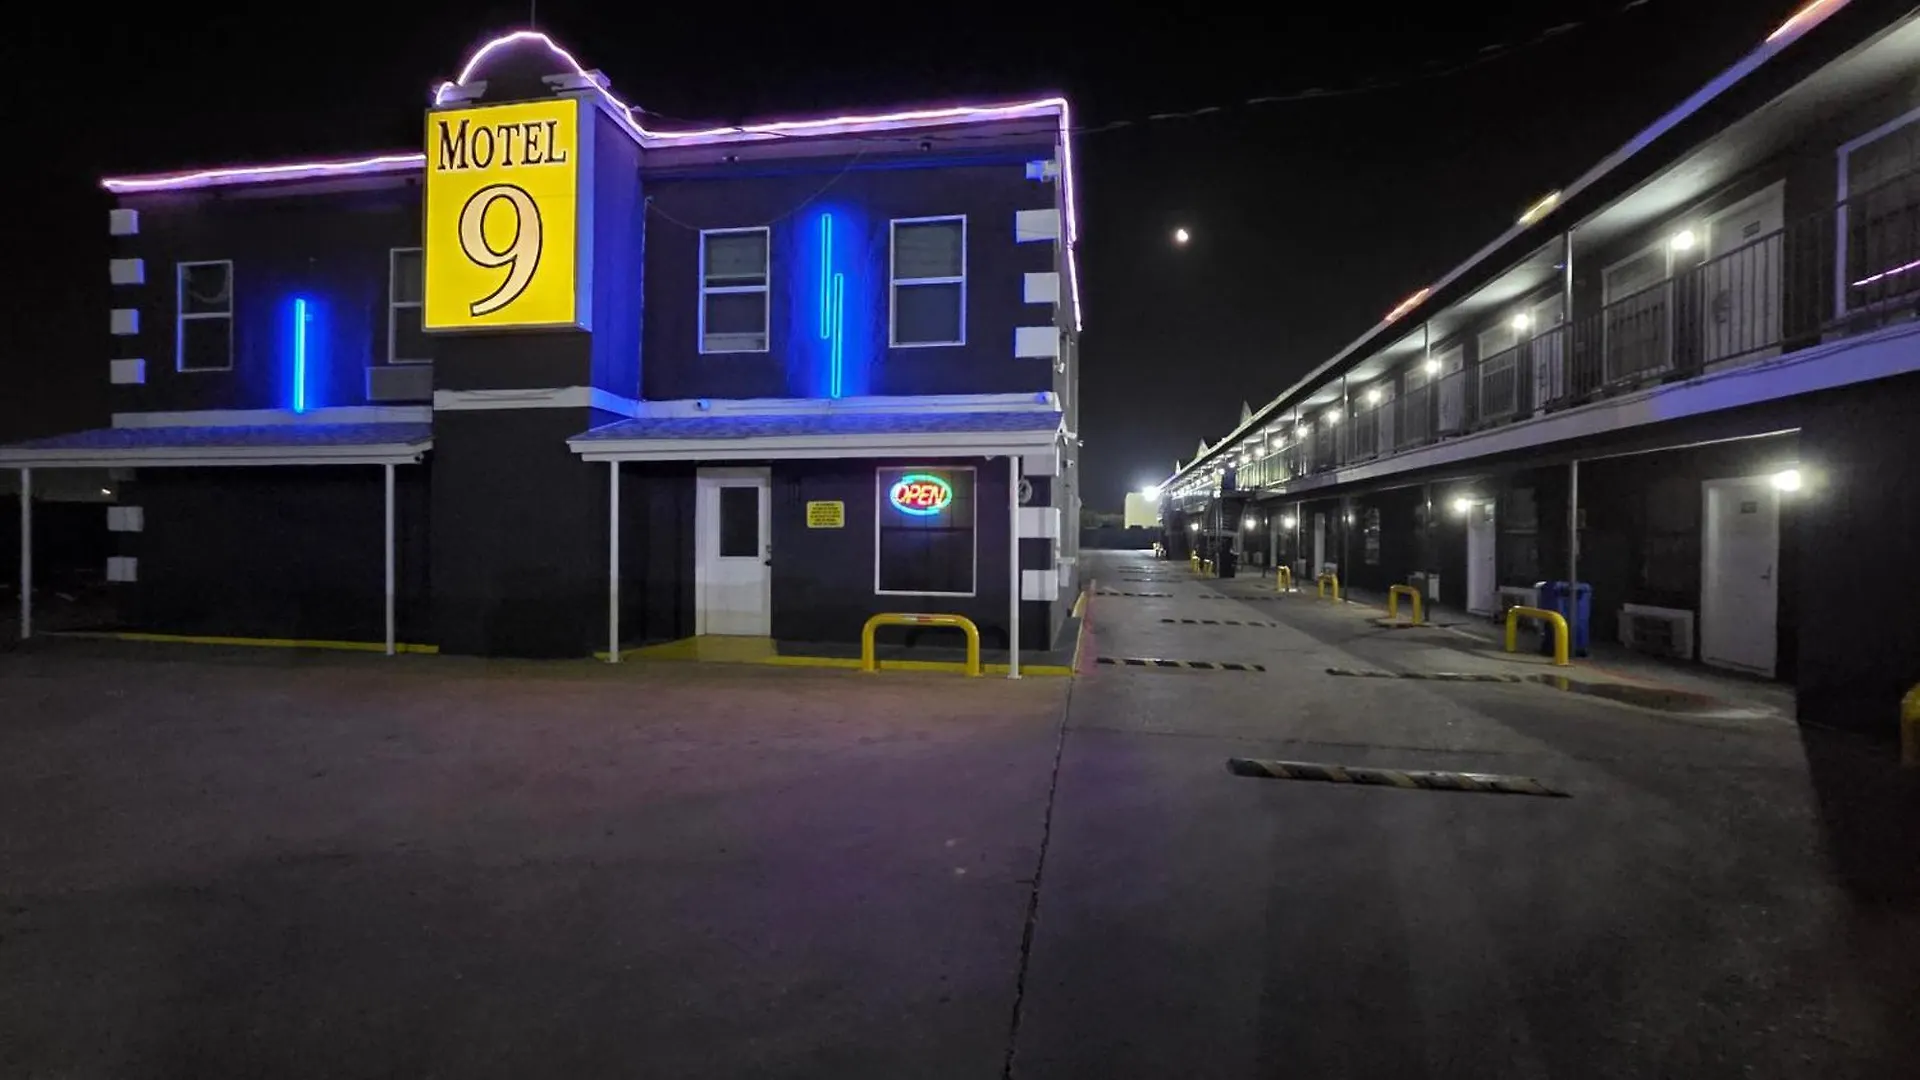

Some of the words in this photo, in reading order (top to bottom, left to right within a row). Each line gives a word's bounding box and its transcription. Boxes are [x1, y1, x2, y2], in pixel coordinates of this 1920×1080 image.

[438, 119, 566, 170] MOTEL
[458, 183, 543, 317] 9
[895, 484, 946, 506] OPEN
